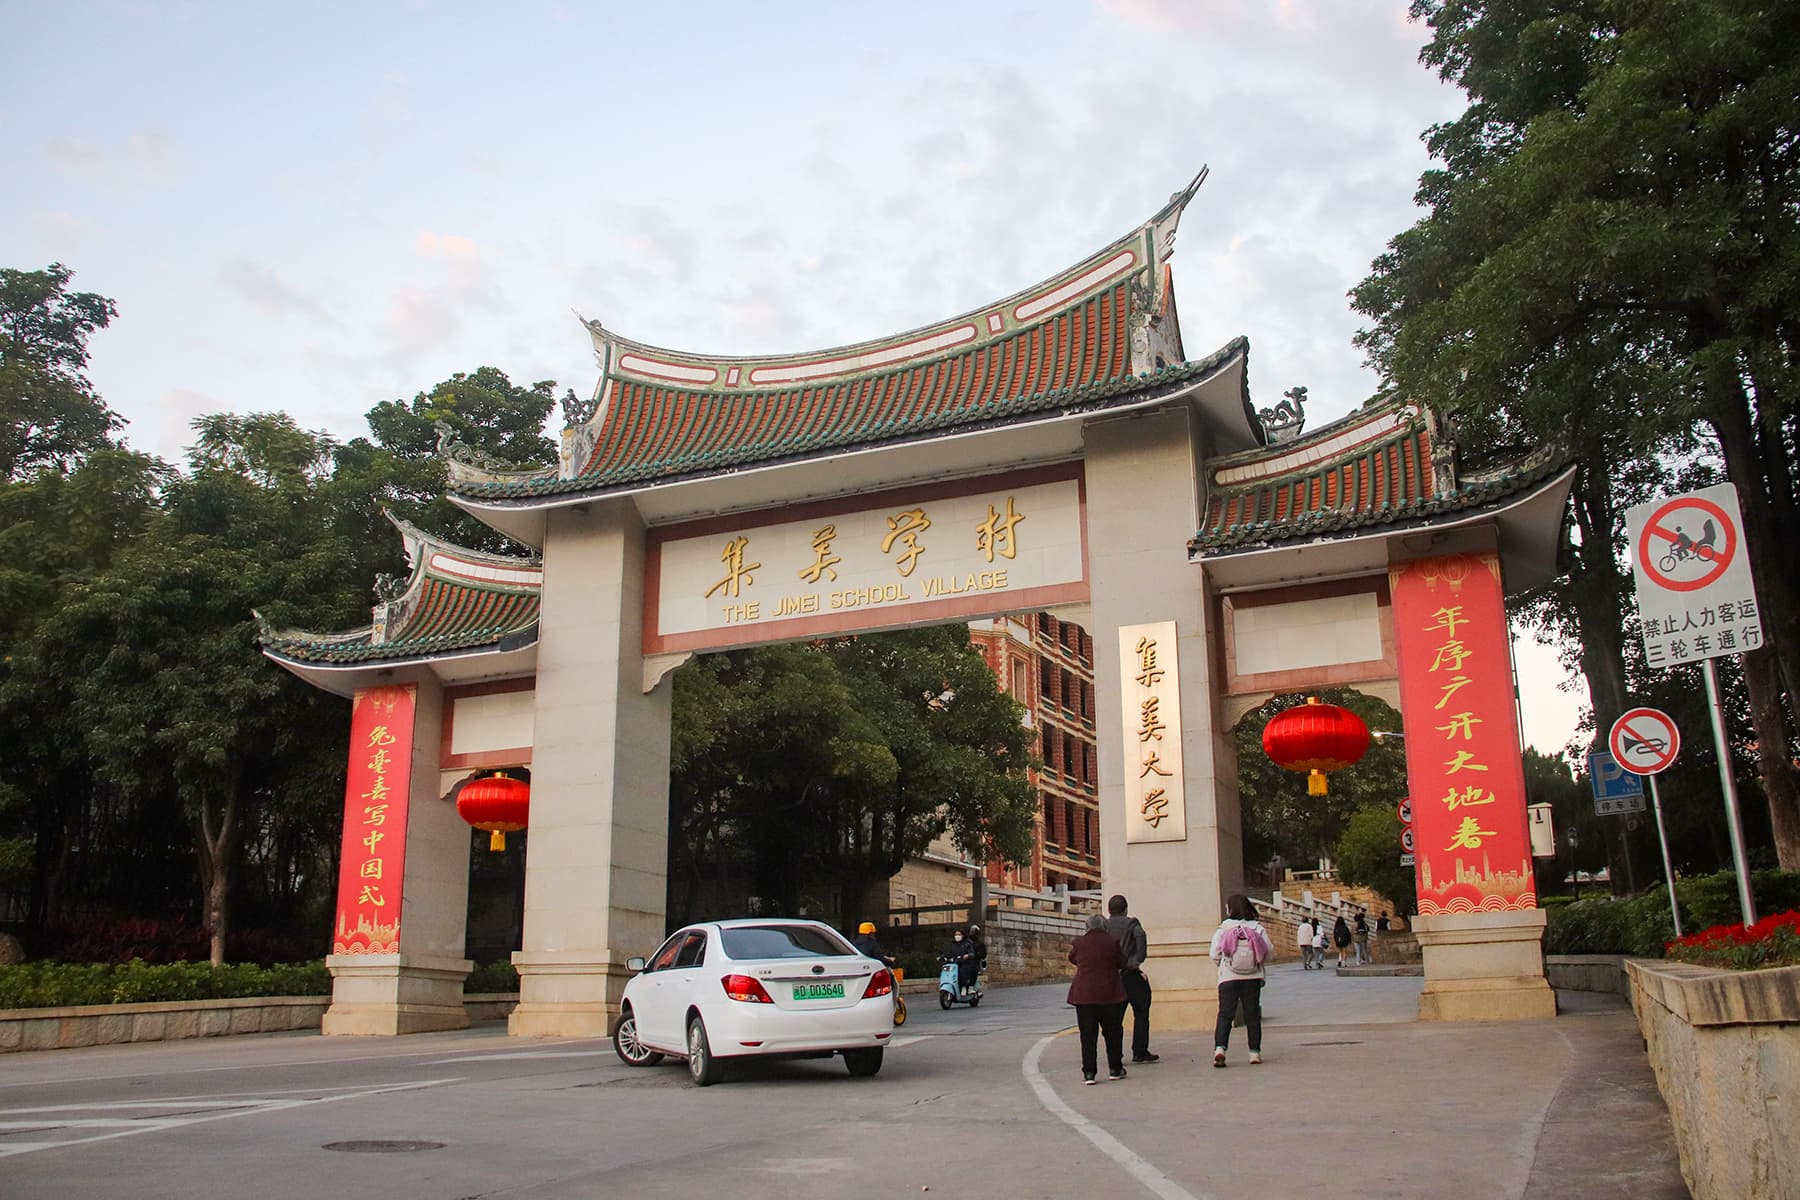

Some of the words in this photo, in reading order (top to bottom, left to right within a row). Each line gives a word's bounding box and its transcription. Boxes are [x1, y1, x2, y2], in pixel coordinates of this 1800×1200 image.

[705, 496, 1025, 599] 集美学村
[722, 601, 760, 624] THE
[771, 593, 819, 617] JIMEI
[830, 583, 910, 609] SCHOOL
[921, 570, 1008, 598] VILLAGE
[1643, 599, 1757, 639] 禁止人力客运
[1649, 625, 1760, 662] 三轮车通行
[1135, 636, 1173, 829] 集美大学
[1596, 757, 1623, 797] P
